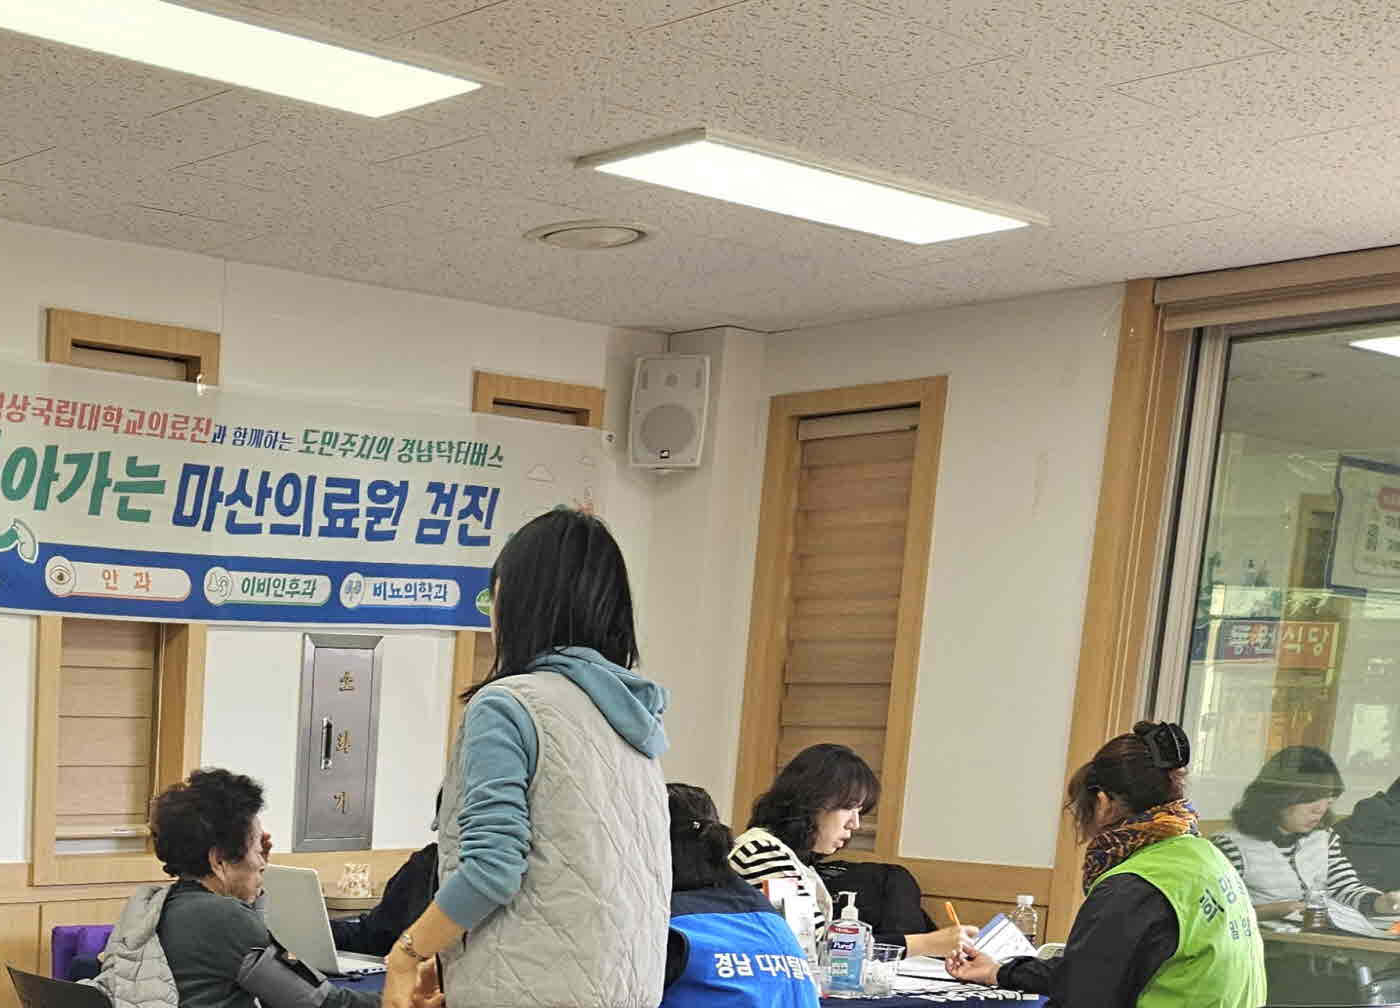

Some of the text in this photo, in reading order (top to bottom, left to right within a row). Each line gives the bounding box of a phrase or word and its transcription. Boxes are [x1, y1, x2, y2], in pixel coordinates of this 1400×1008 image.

[232, 426, 296, 452] 함께하는
[300, 428, 395, 462] 도민주치의
[397, 437, 504, 469] 경남닥터버스
[171, 462, 410, 542] 마산의료원
[415, 481, 501, 547] 검진
[241, 578, 317, 599] 이비인후과
[372, 582, 449, 602] 비뇨의학과
[714, 953, 754, 978] 경남
